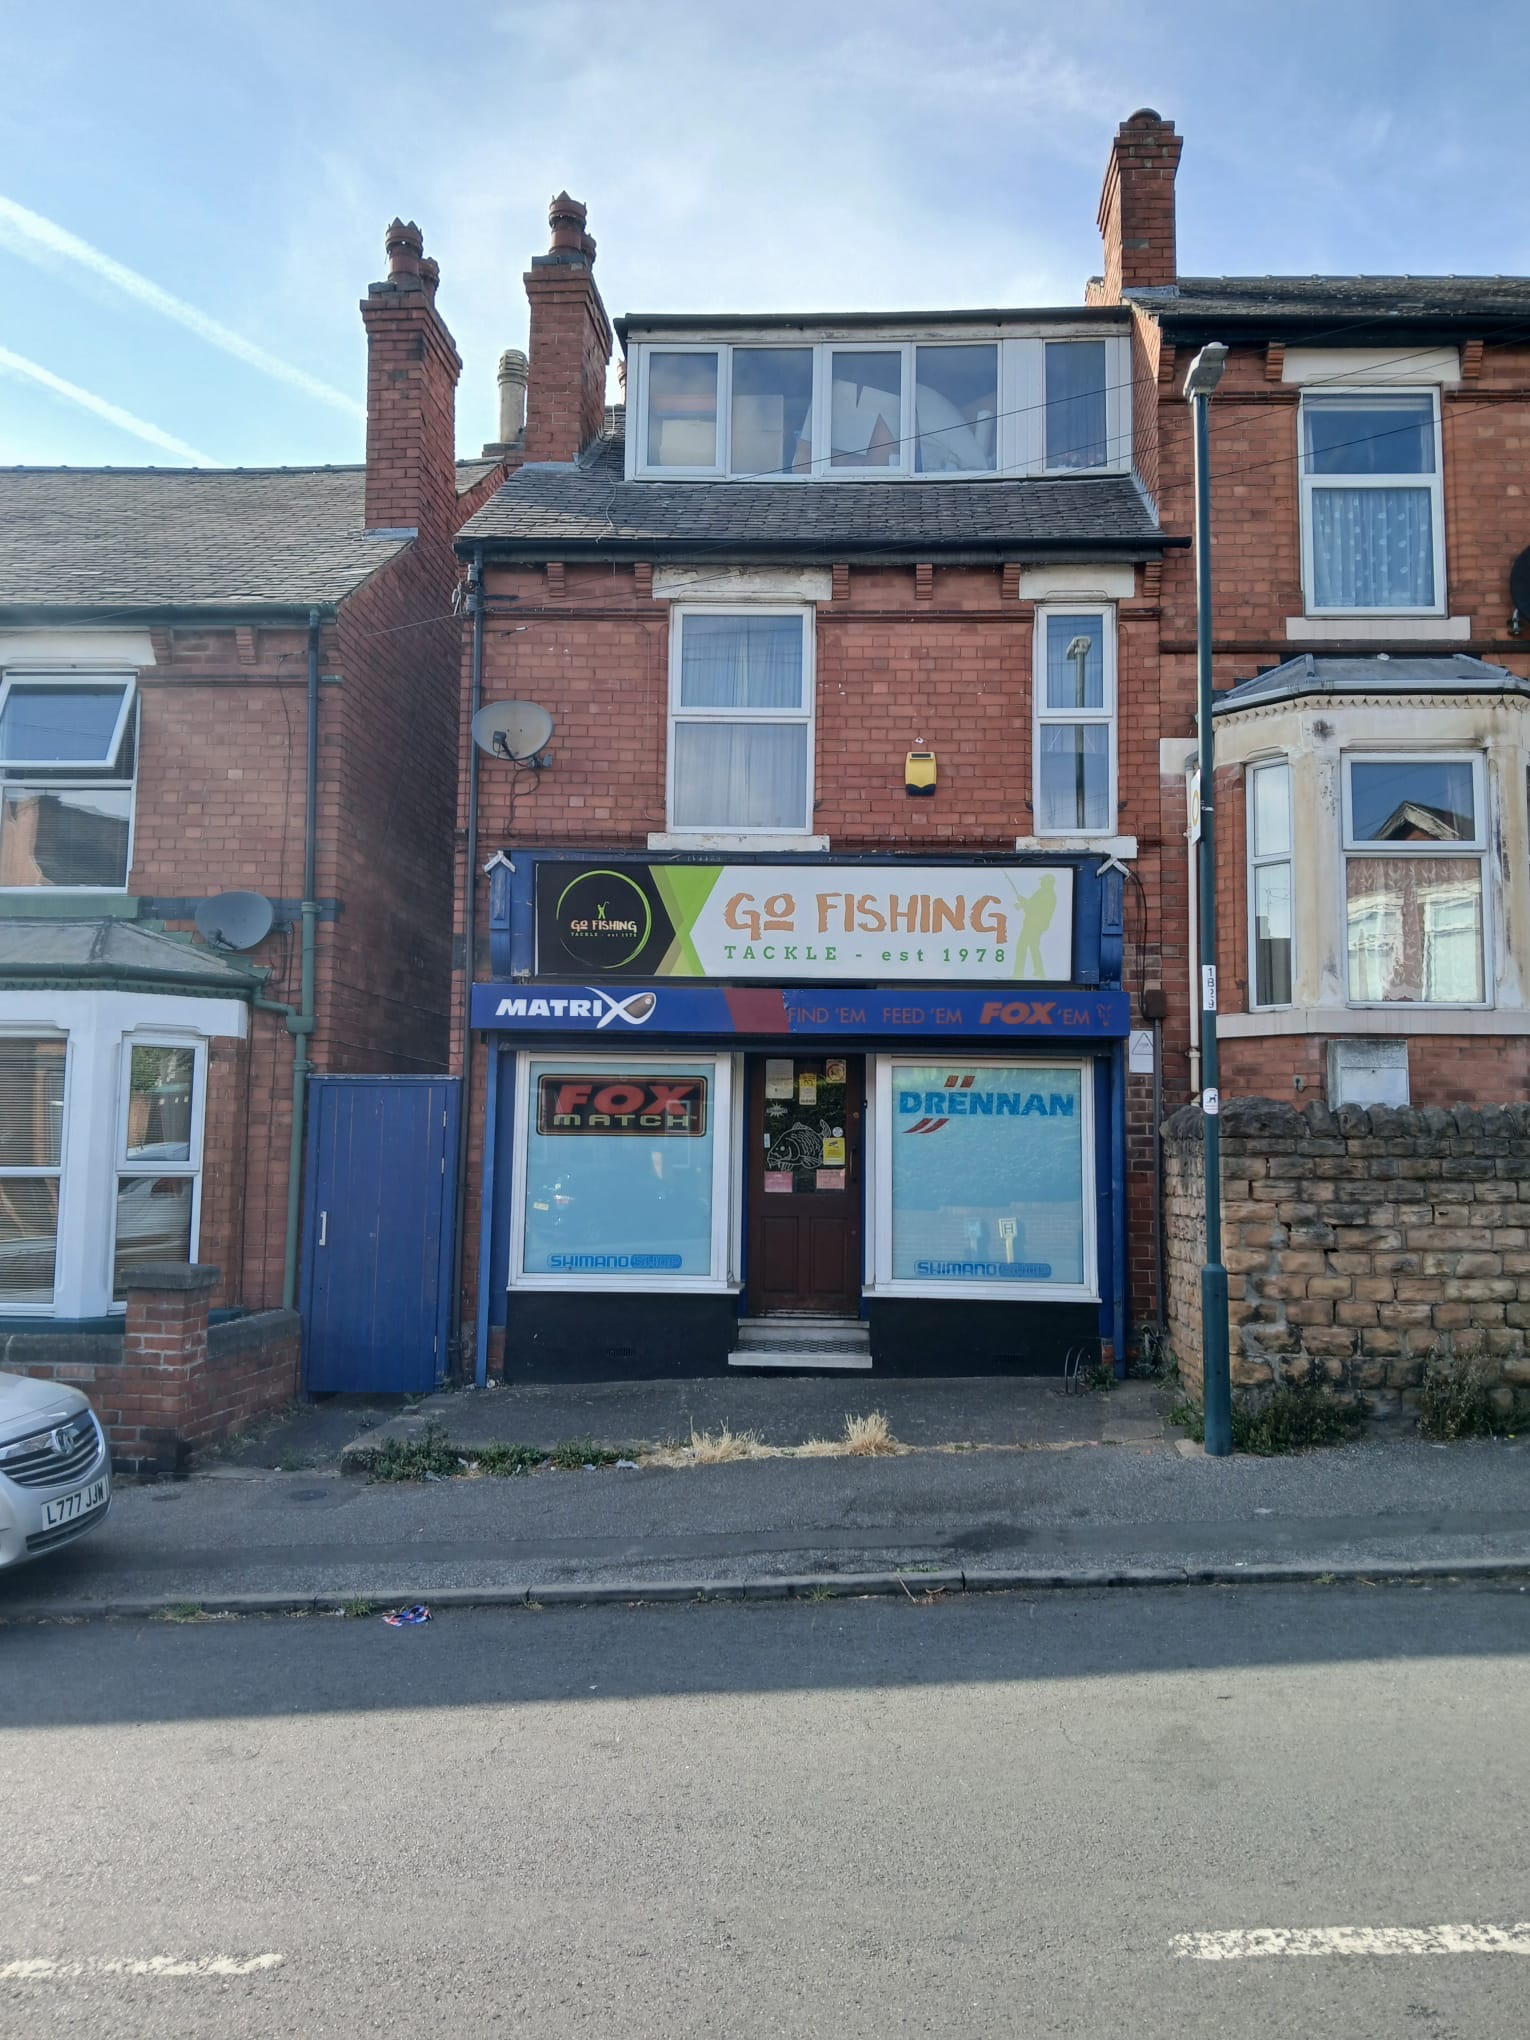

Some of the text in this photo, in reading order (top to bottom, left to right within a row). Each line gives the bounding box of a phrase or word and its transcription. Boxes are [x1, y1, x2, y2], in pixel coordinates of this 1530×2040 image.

[591, 919, 637, 933] FISHING
[816, 892, 1008, 944] FISHING
[724, 946, 837, 961] TACKLE
[881, 949, 924, 963] est
[943, 948, 1006, 963] 1978
[495, 986, 657, 1029] MATRIX
[788, 1007, 830, 1023] FIND
[883, 1007, 925, 1024] FEED
[979, 1001, 1057, 1025] FOX
[555, 1084, 694, 1115] FOX
[898, 1091, 1075, 1117] DRENNAN
[553, 1114, 689, 1127] MATCH
[550, 1255, 629, 1268] SHIMANO
[916, 1261, 996, 1276] SHIMANO
[47, 1492, 82, 1525] L777
